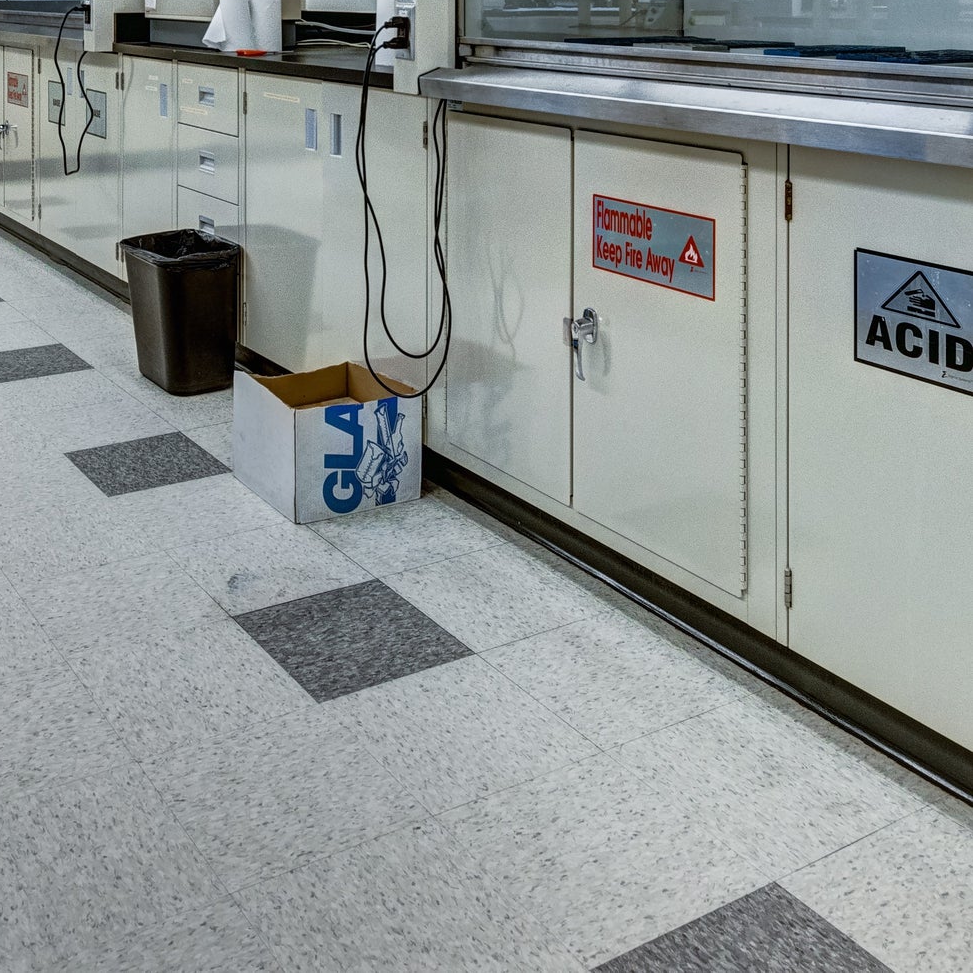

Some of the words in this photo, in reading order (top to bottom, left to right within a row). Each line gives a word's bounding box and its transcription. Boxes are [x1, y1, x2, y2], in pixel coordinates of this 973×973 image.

[596, 199, 653, 241] Flammable
[596, 234, 623, 268] Keep
[625, 241, 643, 269] Fire
[645, 247, 675, 283] Away
[865, 314, 973, 373] ACID
